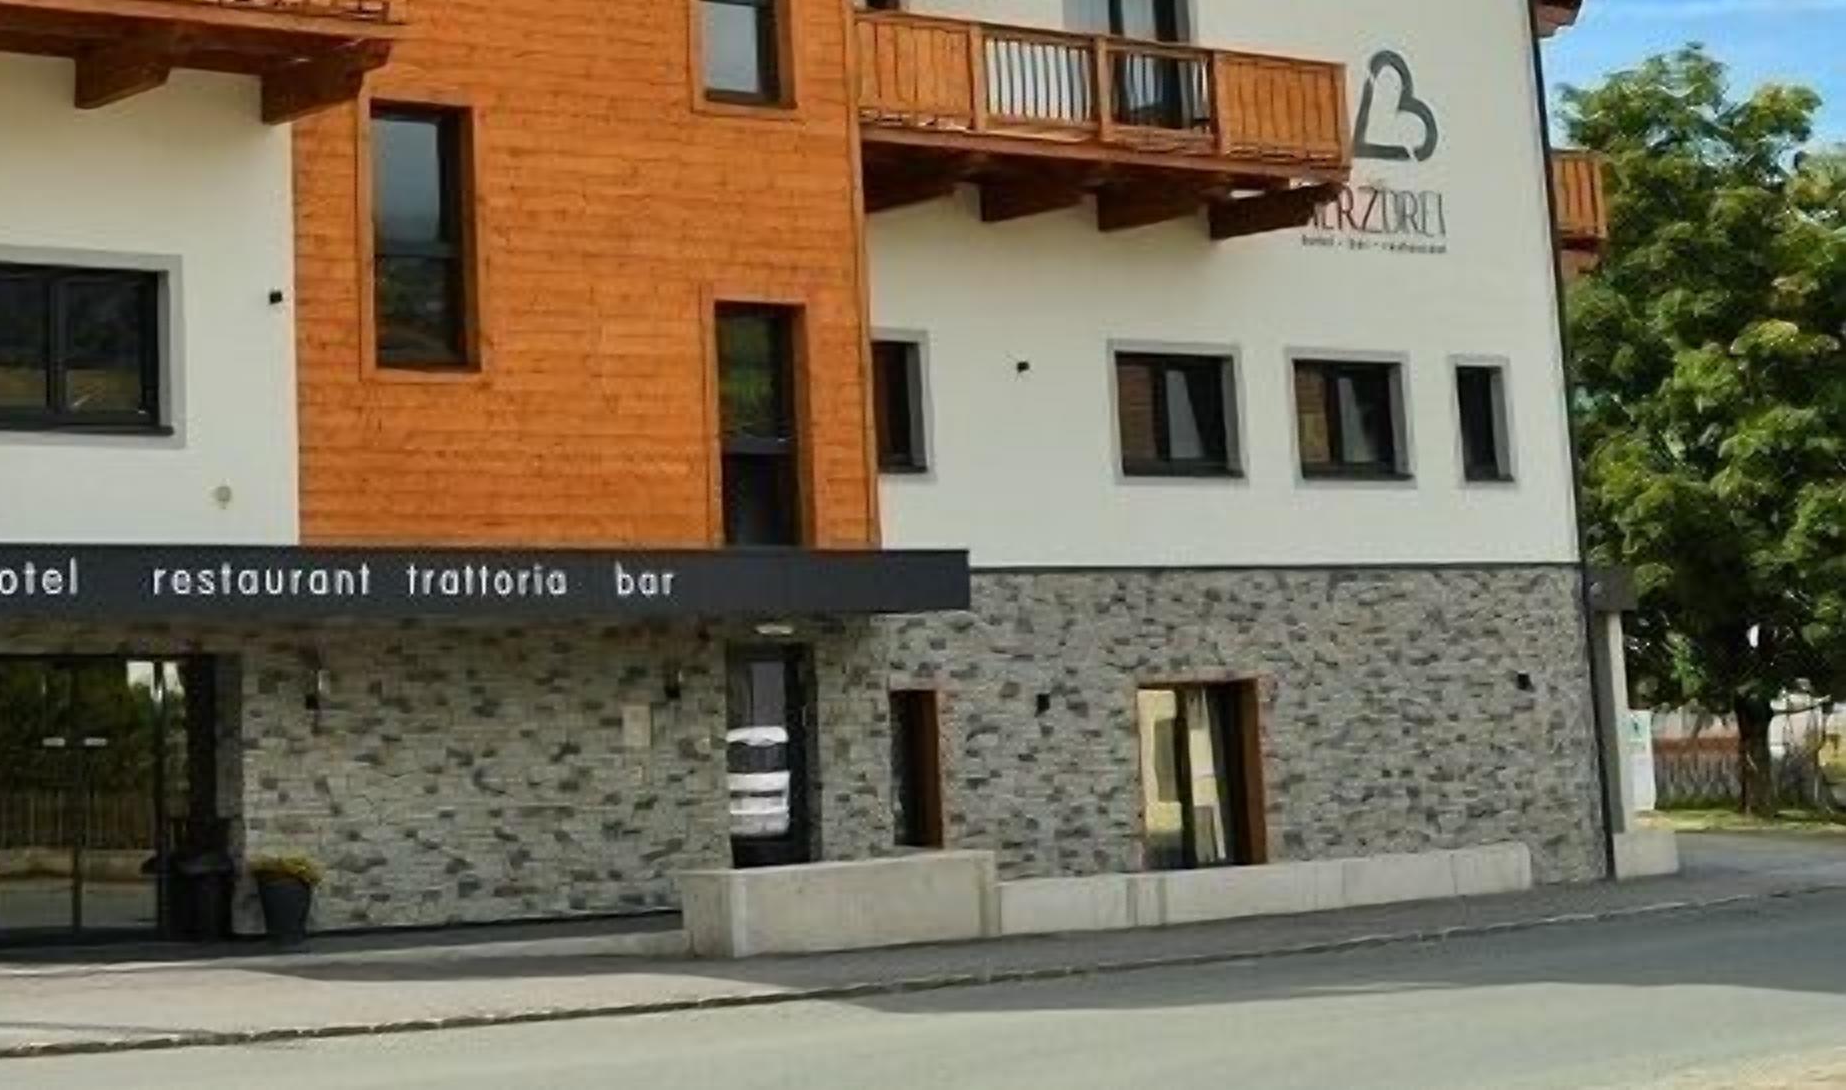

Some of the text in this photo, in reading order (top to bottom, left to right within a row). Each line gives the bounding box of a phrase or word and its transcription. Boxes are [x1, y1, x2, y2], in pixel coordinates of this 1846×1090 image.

[152, 561, 370, 596] restaurant
[406, 562, 568, 596] trattoria
[614, 560, 675, 597] bar
